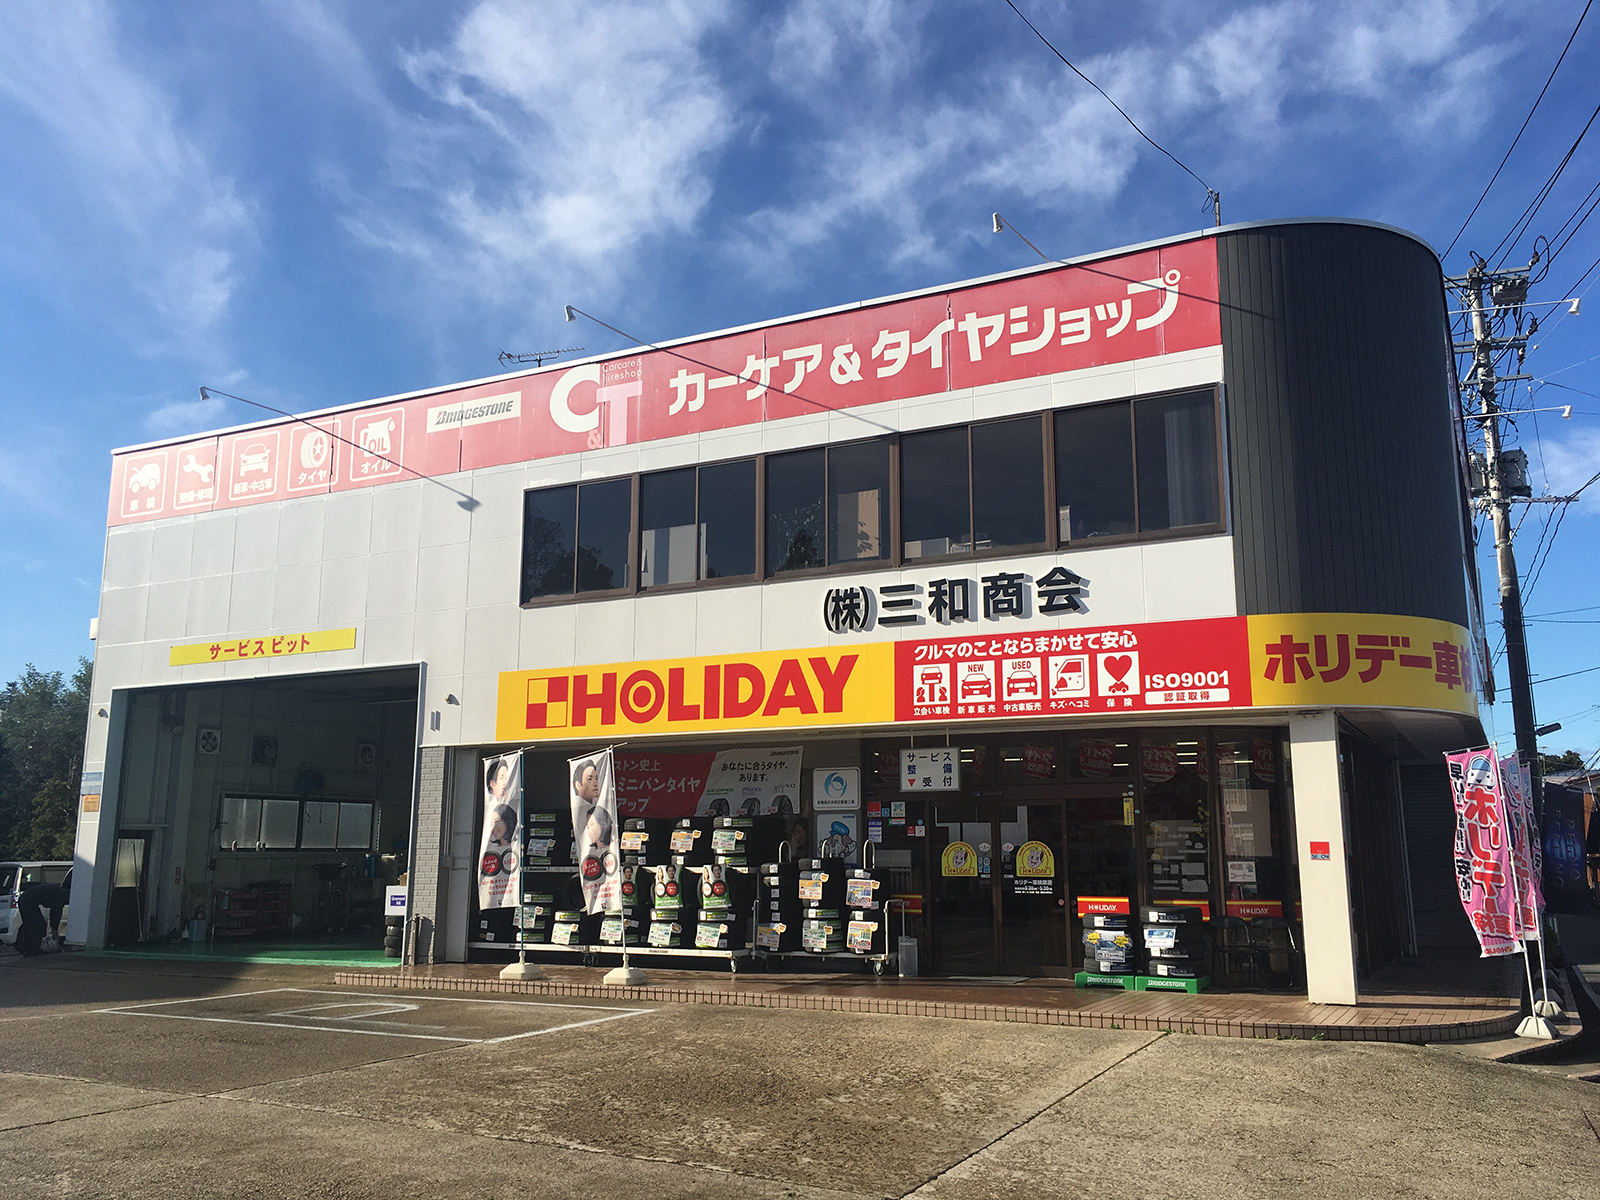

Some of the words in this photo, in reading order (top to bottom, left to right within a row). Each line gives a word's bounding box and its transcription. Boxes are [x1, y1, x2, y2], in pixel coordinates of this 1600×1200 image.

[435, 400, 514, 425] BRIDGESTONE
[368, 439, 387, 452] OIL
[360, 457, 392, 475] オイル
[298, 469, 327, 485] タイヤ
[913, 630, 1138, 662] クルマのことならまかせて安心
[967, 663, 984, 673] NEW
[1011, 660, 1032, 670] USED
[1145, 670, 1230, 689] ISO9001
[573, 654, 858, 726] HOLIDAY
[1106, 697, 1133, 708] 保険
[1163, 690, 1211, 703] 認証取得
[914, 705, 951, 715] 立会い車検
[957, 705, 996, 714] 新車販売
[1003, 701, 1042, 712] 中古車販売
[907, 752, 953, 763] サービス
[907, 763, 953, 776] 整備
[922, 776, 953, 788] 受付
[1088, 903, 1117, 911] HOLIDAY
